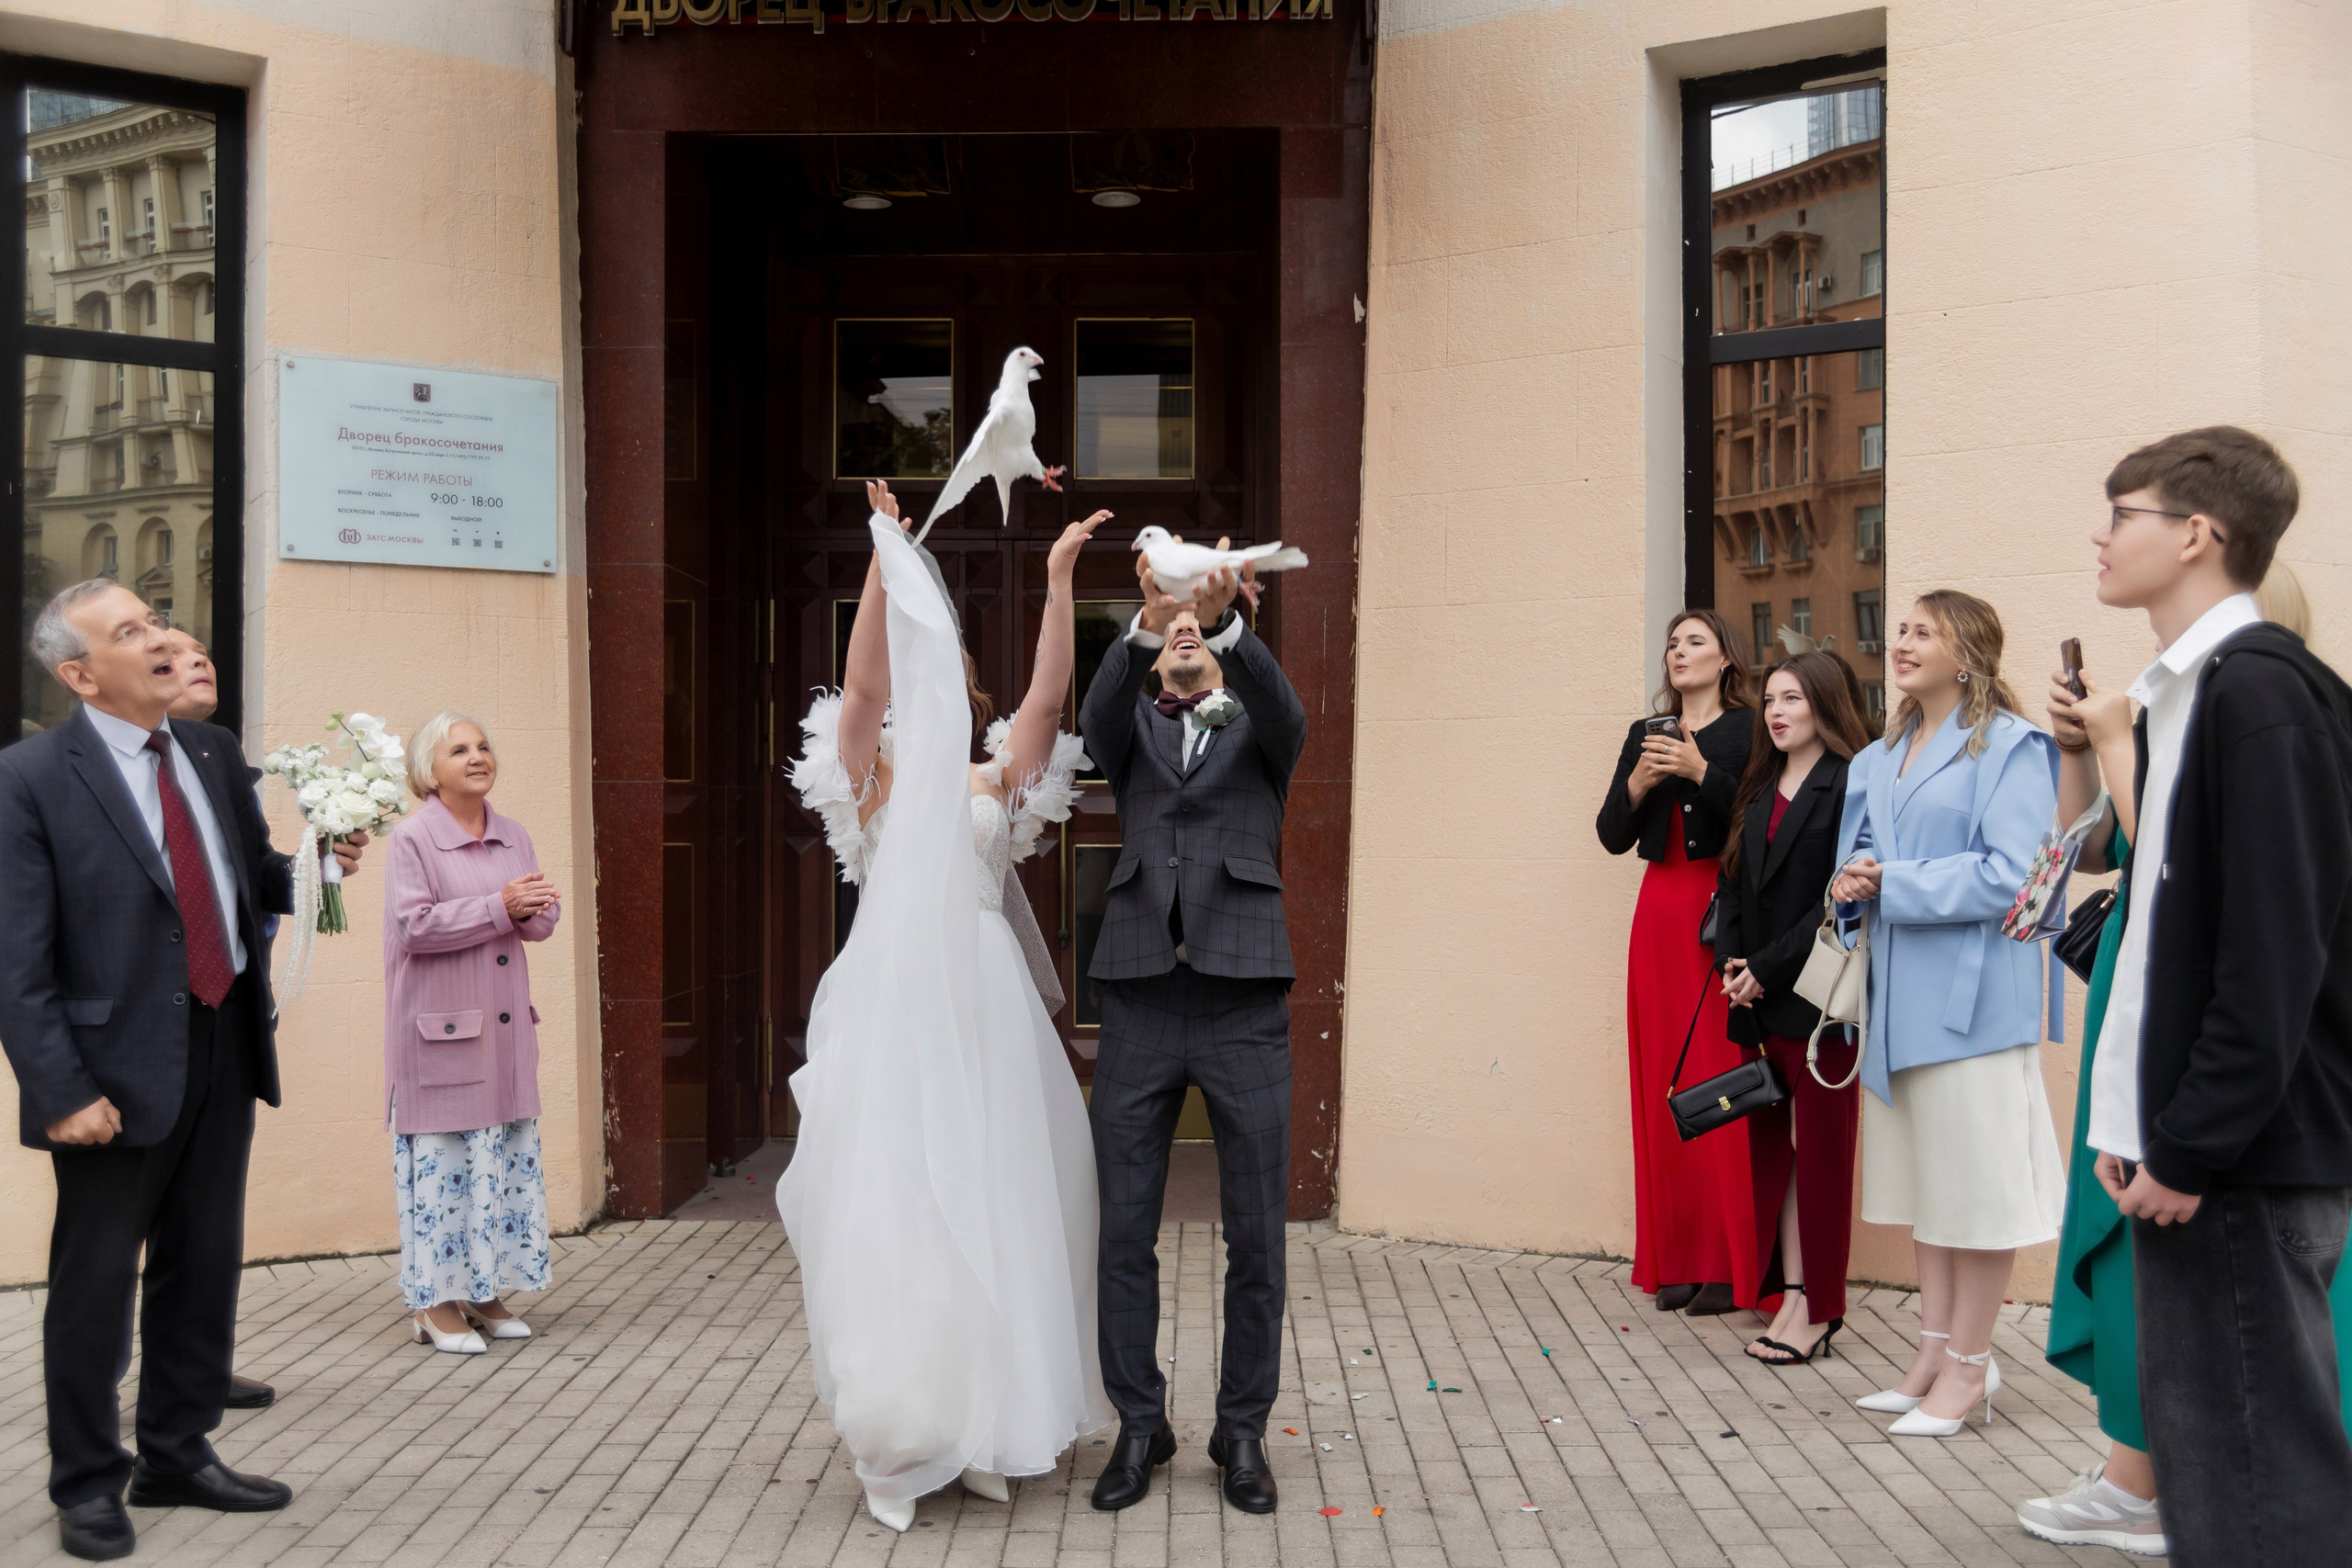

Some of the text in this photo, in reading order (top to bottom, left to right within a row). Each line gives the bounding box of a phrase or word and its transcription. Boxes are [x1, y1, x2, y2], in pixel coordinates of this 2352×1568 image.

[423, 411, 462, 419] ГРАЖДАНСКОГО
[337, 427, 503, 452] Дворец бракосочетания
[371, 469, 472, 487] РЕЖИМ РАБОТЫ
[431, 492, 458, 505] 9:00
[471, 496, 503, 508] 18:00
[379, 510, 421, 518] ПОНЕДЕЛЬНИК
[367, 534, 424, 544] ЗАГС МОСКВЫ
